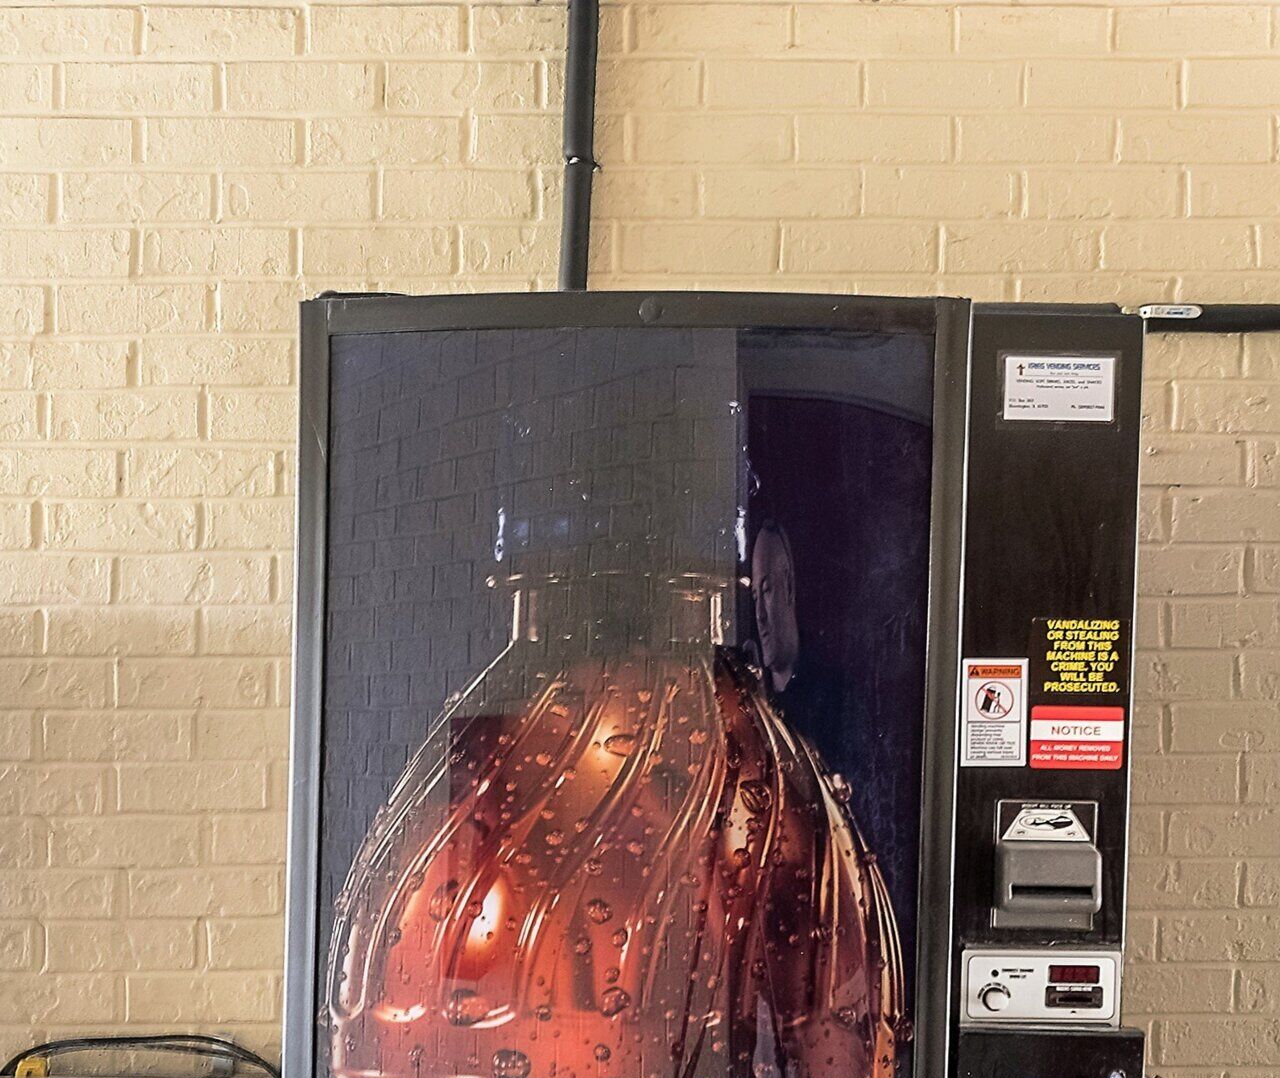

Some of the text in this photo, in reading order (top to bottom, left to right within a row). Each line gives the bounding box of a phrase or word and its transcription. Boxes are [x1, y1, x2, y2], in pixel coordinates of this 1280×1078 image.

[1046, 619, 1120, 630] VANDALIZING
[1046, 630, 1120, 641] OR STEALING
[1053, 640, 1113, 651] FROM THIS
[1046, 650, 1120, 661] MACHINE IS A
[979, 667, 1020, 676] WARNING
[1050, 661, 1114, 672] CRIME. YOU
[1060, 672, 1104, 682] WILL BE
[1043, 681, 1121, 693] PROSECUTED.
[1050, 725, 1102, 736] NOTICE
[1040, 744, 1053, 752] ALL
[1053, 744, 1078, 752] MONEY
[1031, 753, 1052, 761] FROM
[1068, 754, 1099, 762] MACHINE
